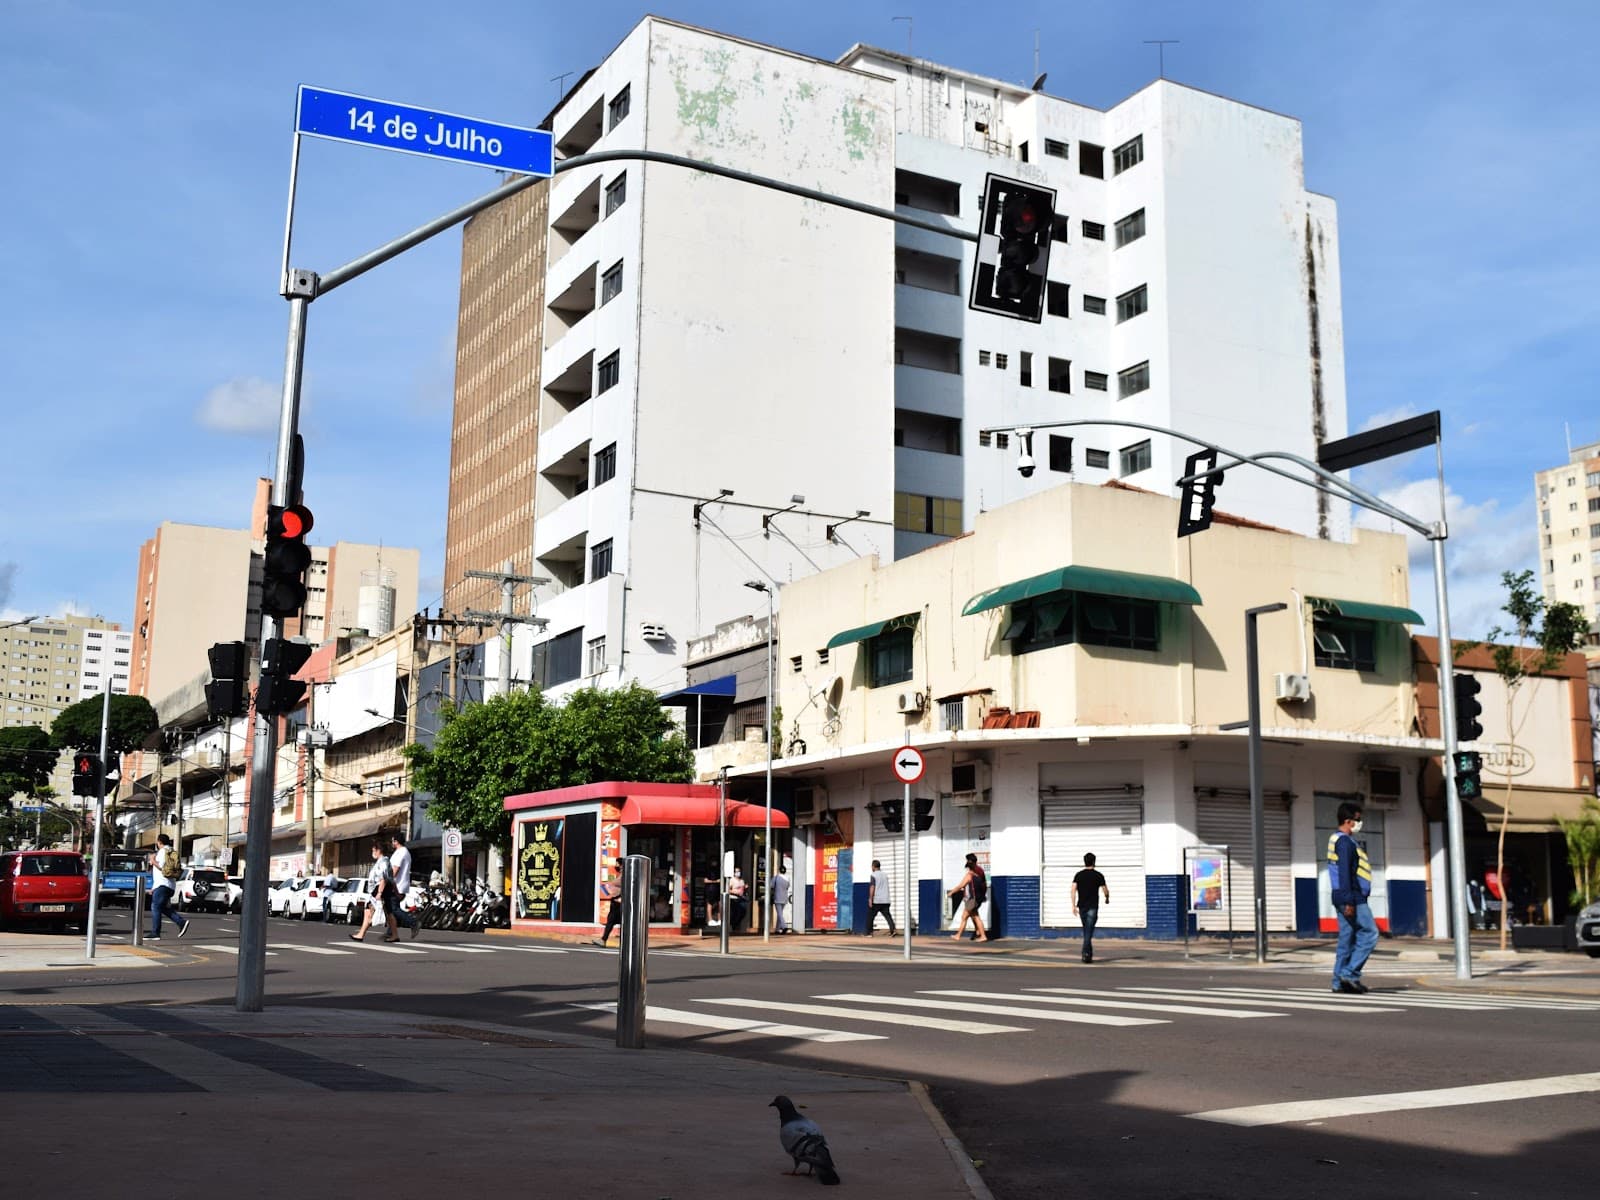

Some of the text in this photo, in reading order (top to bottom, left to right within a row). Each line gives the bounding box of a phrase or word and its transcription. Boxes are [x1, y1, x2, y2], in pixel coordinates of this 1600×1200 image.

[348, 107, 503, 157] 14 de Julho
